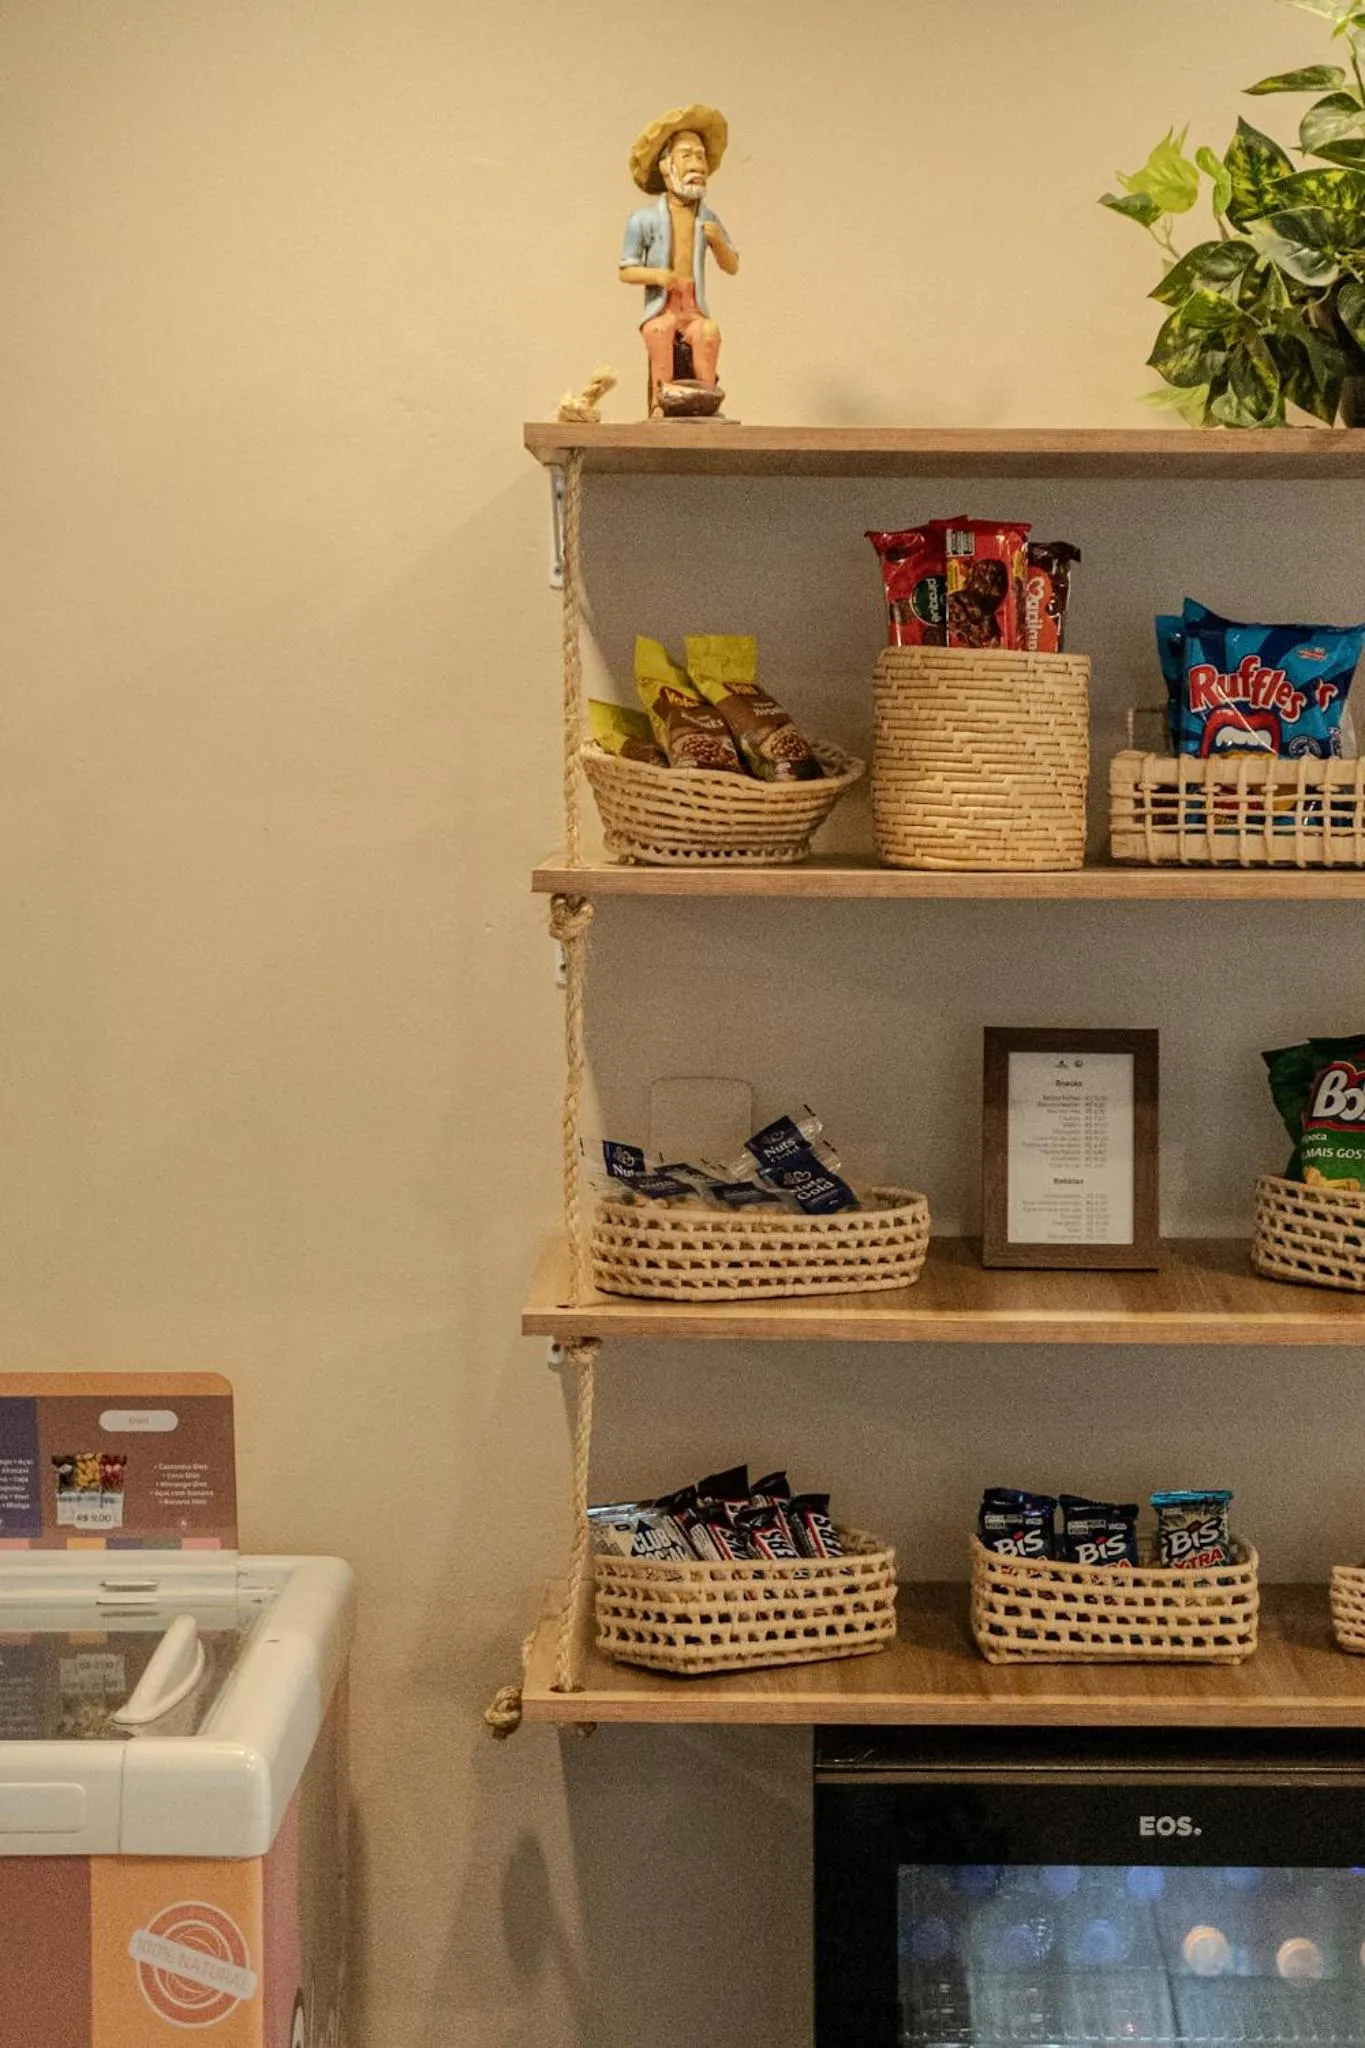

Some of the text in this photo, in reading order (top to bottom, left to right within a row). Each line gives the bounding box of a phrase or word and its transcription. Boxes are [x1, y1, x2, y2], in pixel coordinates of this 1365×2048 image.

[1188, 655, 1306, 723] Ruffles
[1312, 1070, 1365, 1121] Bo
[1336, 1148, 1365, 1159] GOS
[633, 1527, 672, 1553] CLUB
